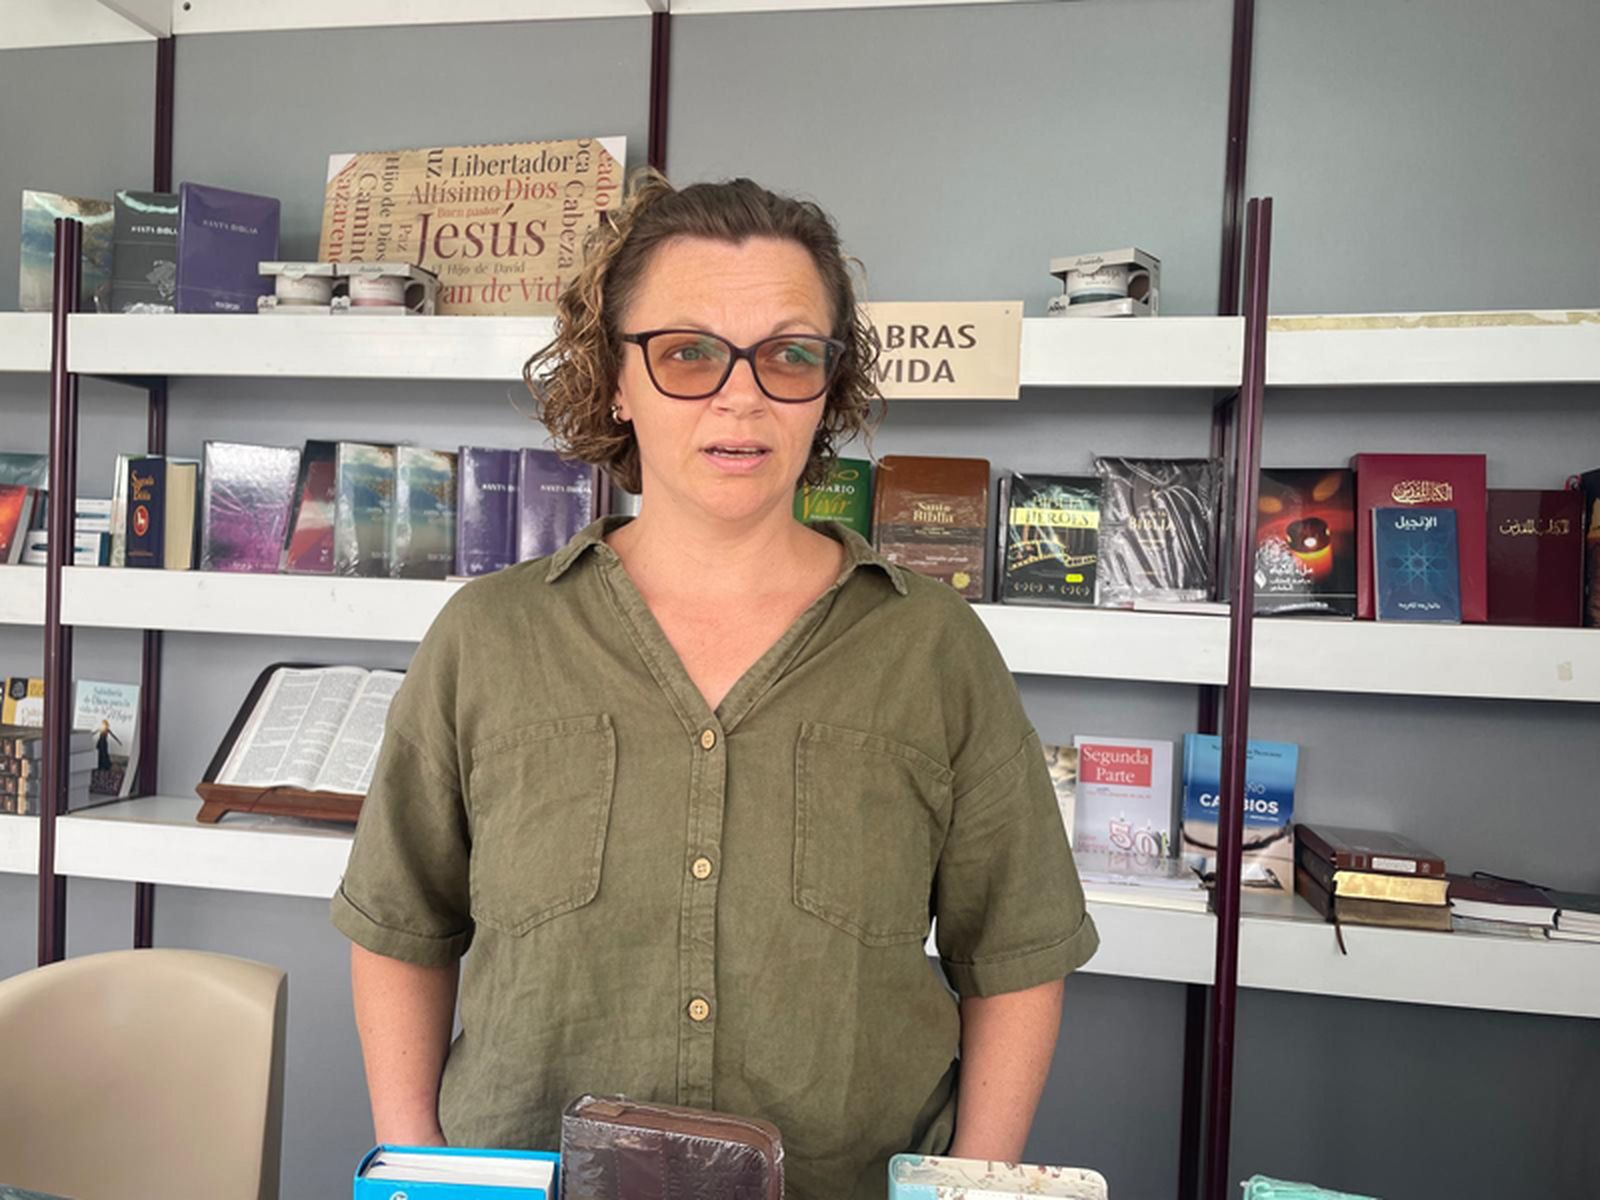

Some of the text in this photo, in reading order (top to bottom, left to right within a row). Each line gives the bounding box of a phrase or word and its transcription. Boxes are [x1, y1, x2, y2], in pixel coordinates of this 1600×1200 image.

[451, 150, 575, 178] Libertador
[407, 177, 558, 206] Altísimo Dios
[376, 157, 400, 262] Hijo de Dios
[398, 224, 413, 253] Paz
[416, 202, 548, 267] Jesús
[558, 180, 585, 269] Cabeza
[481, 274, 512, 304] de
[520, 275, 568, 304] Vid
[875, 359, 955, 383] VIDA
[1394, 516, 1438, 532] الإنجيل
[1082, 746, 1150, 767] Segunda
[1095, 766, 1136, 783] Parte
